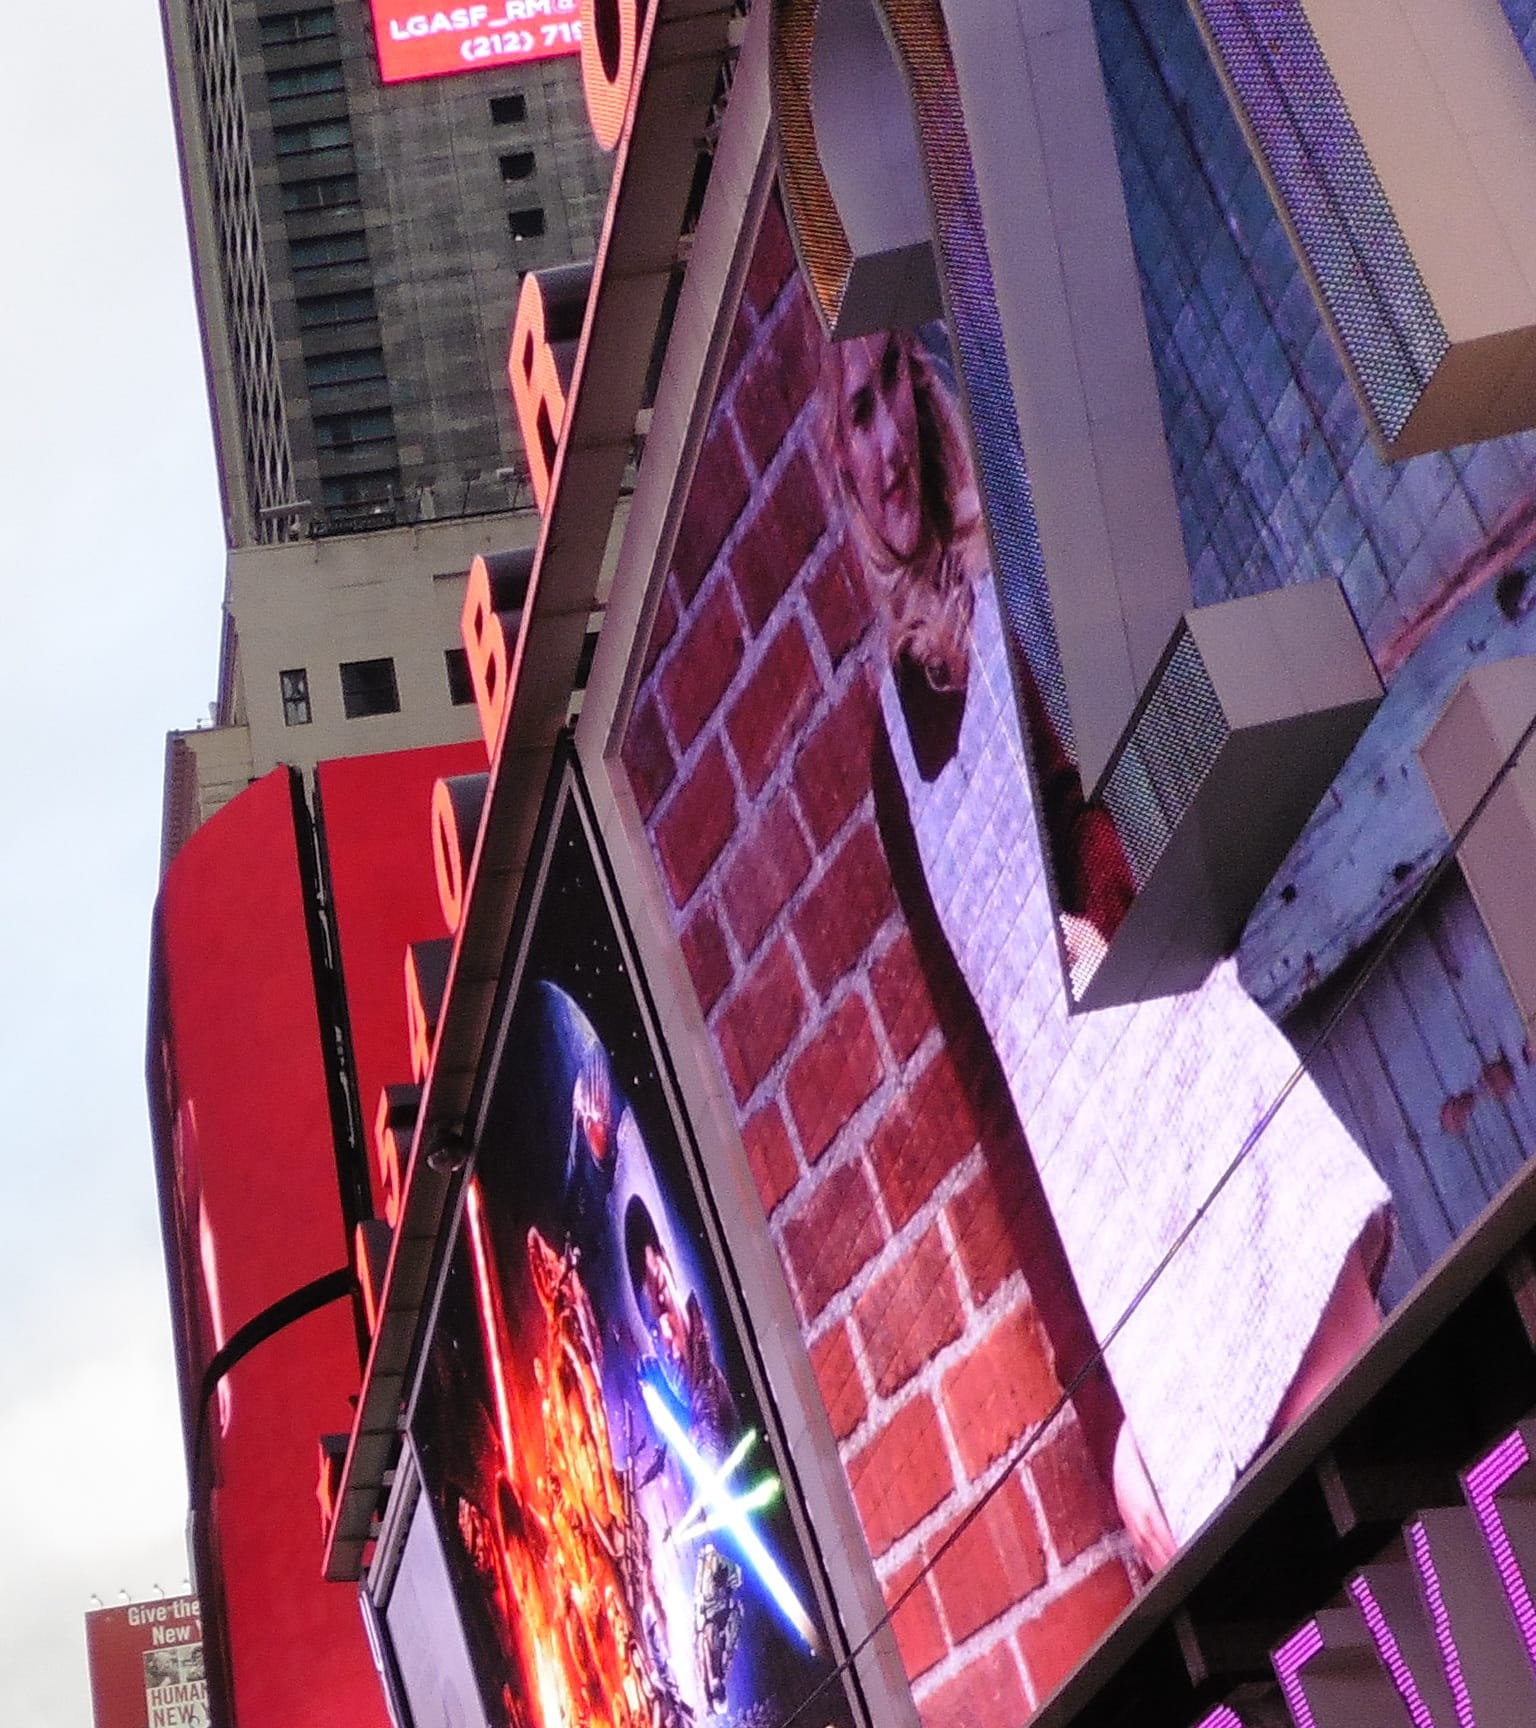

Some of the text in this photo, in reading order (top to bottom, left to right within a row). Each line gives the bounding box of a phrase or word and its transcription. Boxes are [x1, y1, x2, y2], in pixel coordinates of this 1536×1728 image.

[460, 31, 535, 61] (212)
[128, 1599, 201, 1627] Give the
[152, 1626, 191, 1646] New
